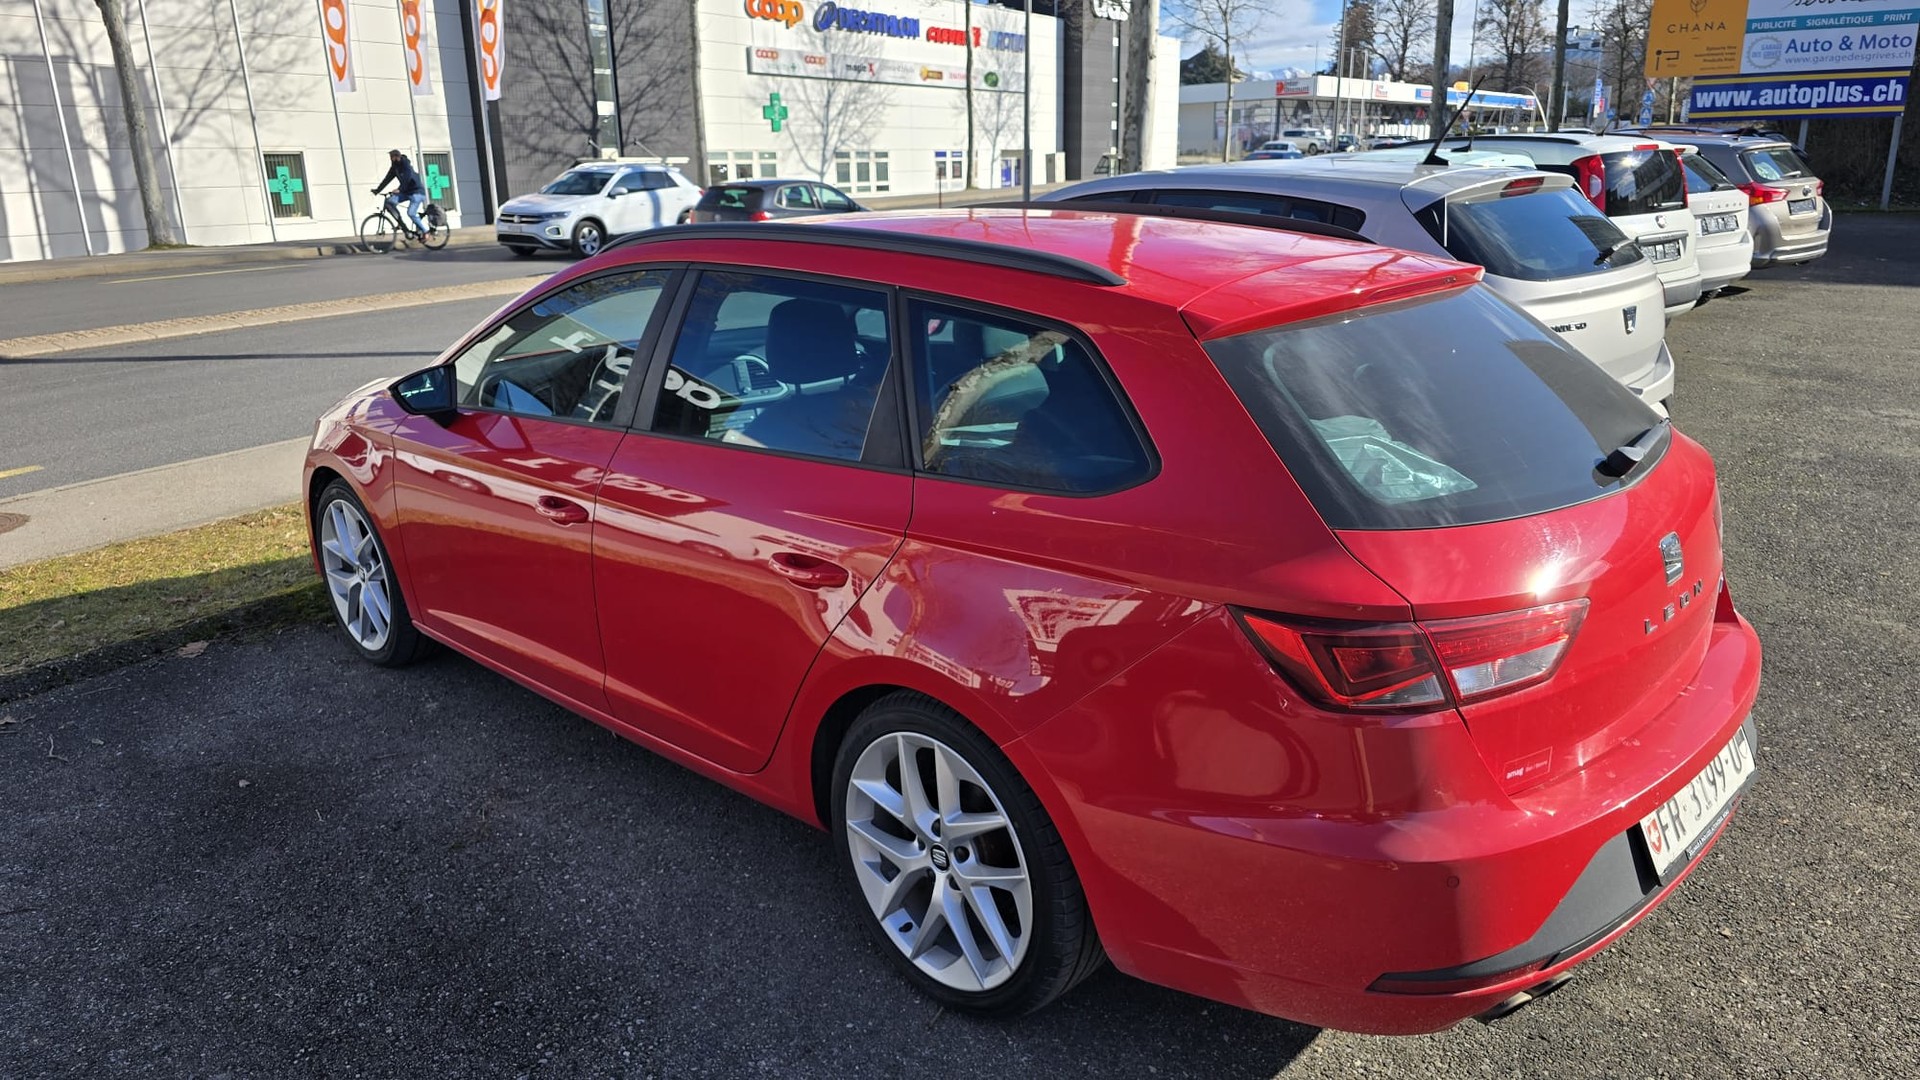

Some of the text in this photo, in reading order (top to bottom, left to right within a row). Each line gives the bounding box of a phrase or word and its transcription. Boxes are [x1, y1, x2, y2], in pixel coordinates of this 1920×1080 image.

[837, 7, 920, 40] DECATHLON
[1666, 21, 1728, 34] CHANA
[1751, 12, 1913, 31] PUBLICITÉ SIGNALÉTIQUE PRINT
[1785, 34, 1913, 54] Auto & Moto
[1785, 50, 1912, 65] www.garagedesgrives.ch
[1695, 79, 1903, 108] www.autoplus.ch
[1644, 579, 1703, 635] LEON
